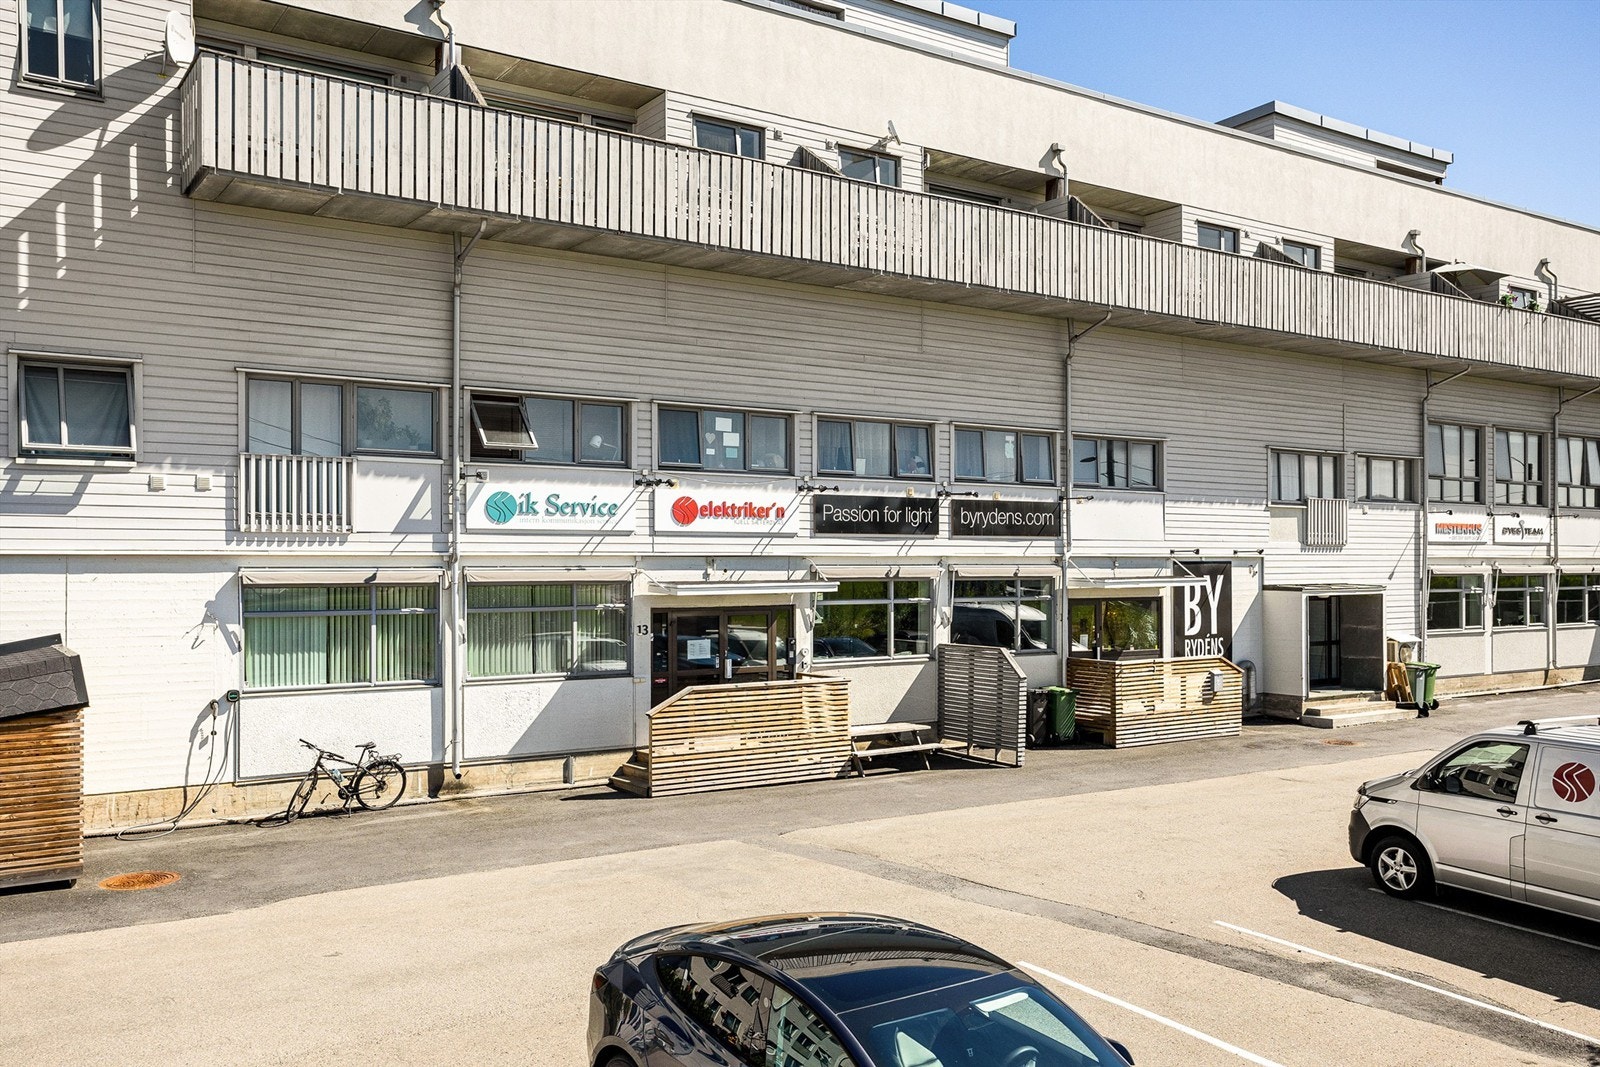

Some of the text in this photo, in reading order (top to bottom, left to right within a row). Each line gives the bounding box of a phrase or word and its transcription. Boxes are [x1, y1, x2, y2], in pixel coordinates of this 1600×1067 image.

[518, 491, 619, 517] ik Service
[823, 504, 933, 527] Passion for light
[960, 508, 1055, 528] byrydens.com
[1524, 527, 1544, 536] TEAM
[1184, 575, 1224, 636] BY
[637, 625, 649, 636] 13
[1184, 633, 1225, 657] RYDÉNS
